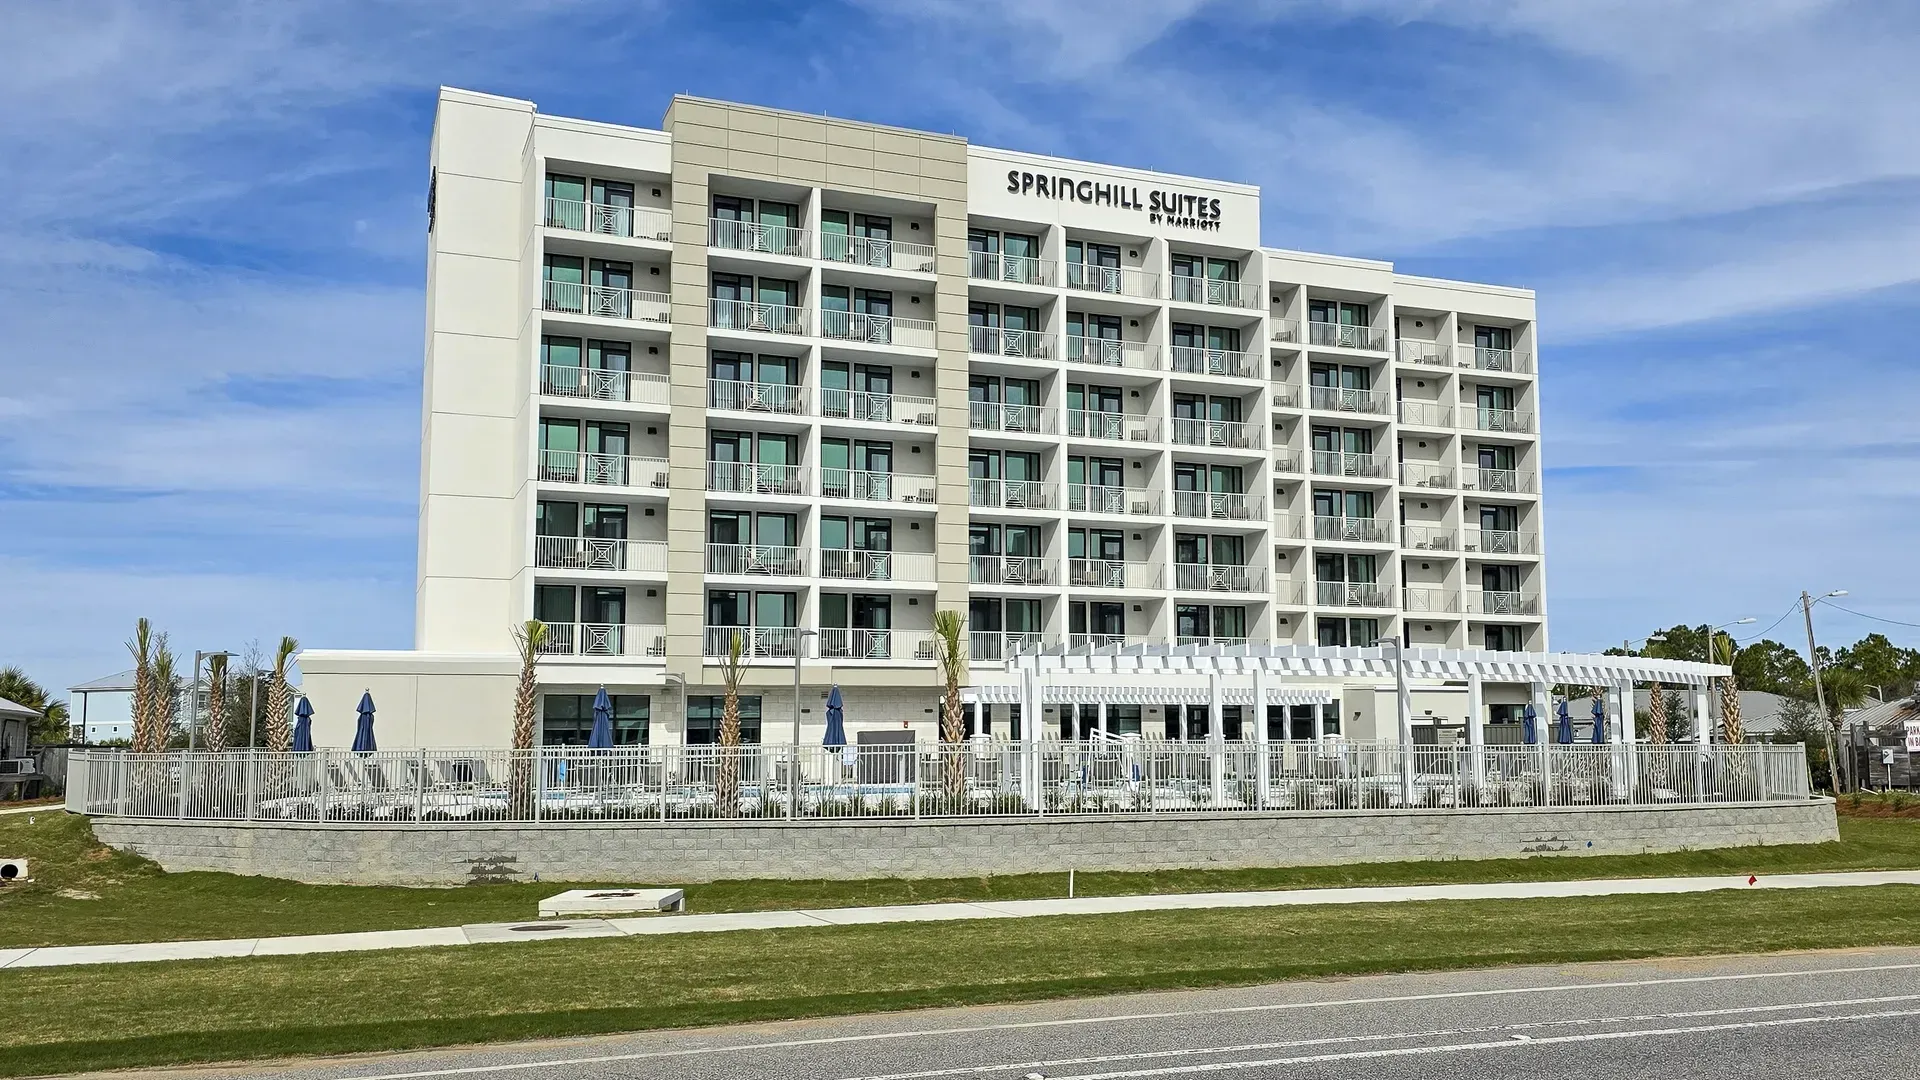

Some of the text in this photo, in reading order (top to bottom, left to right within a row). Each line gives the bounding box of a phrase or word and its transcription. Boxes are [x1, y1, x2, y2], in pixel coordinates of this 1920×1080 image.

[1007, 170, 1221, 219] SPRINGHILL SUITES
[1149, 213, 1221, 232] BY MARRIOTT
